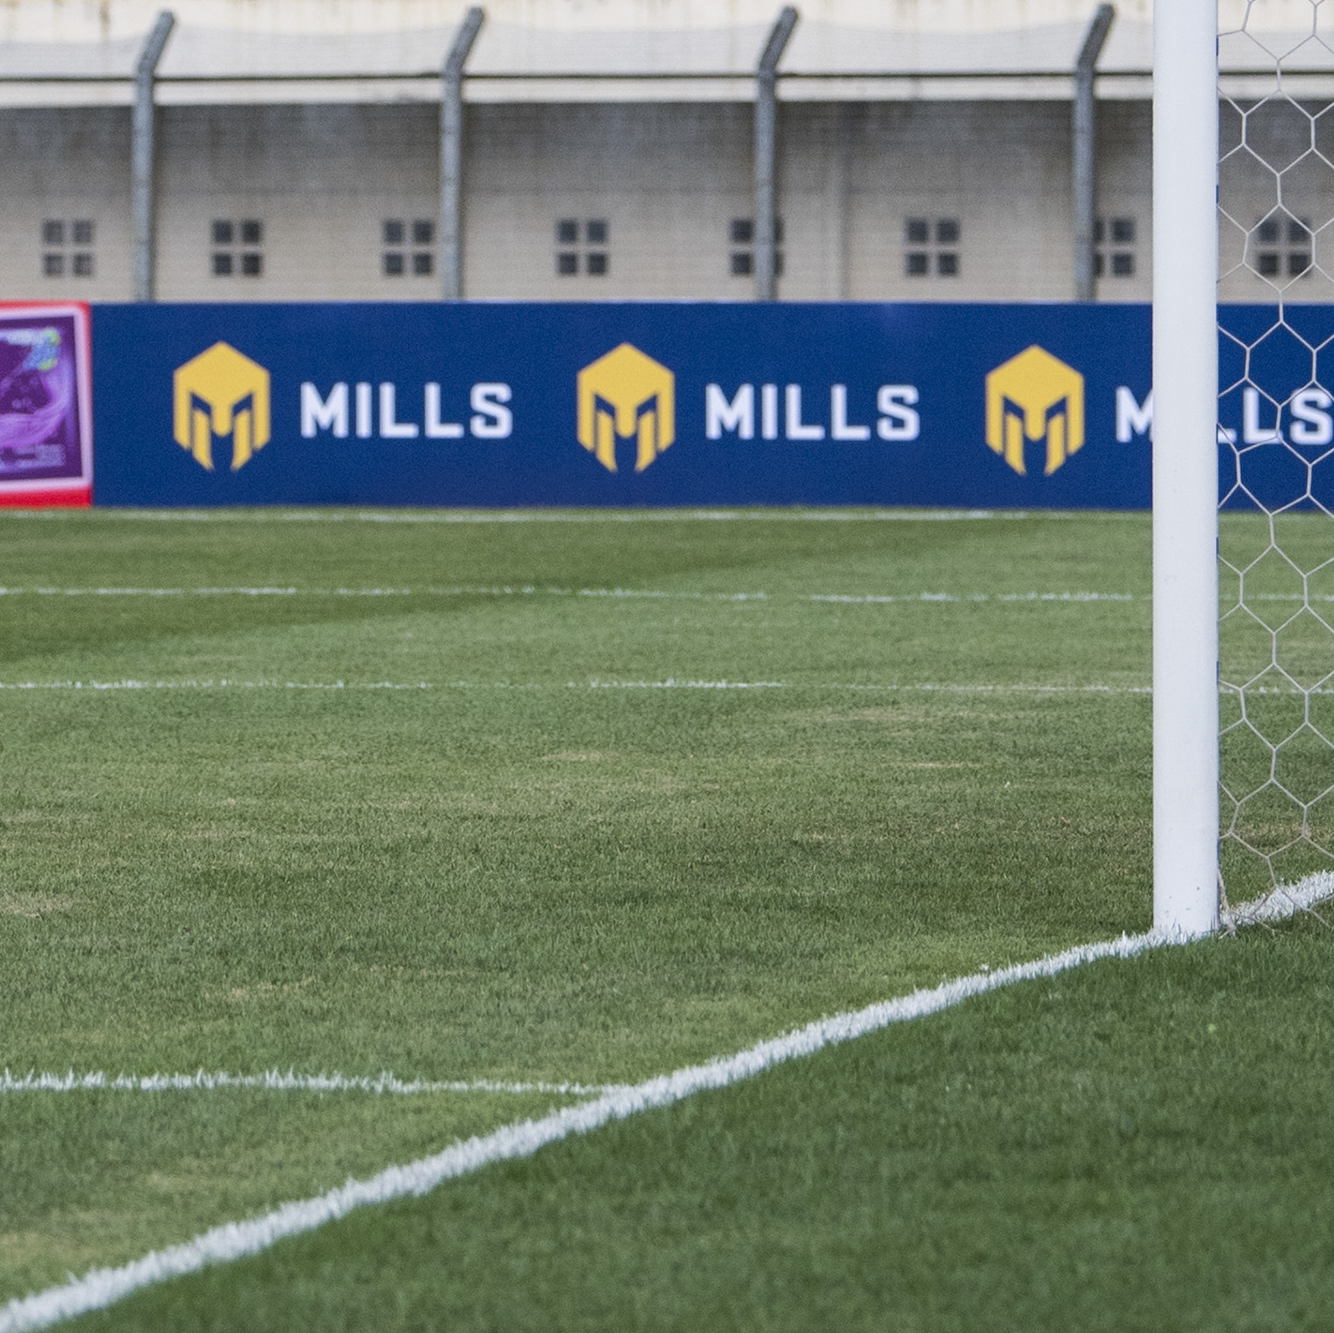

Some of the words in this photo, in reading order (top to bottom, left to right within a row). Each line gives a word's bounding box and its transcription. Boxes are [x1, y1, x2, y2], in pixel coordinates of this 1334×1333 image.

[300, 381, 514, 439] MILLS
[705, 382, 920, 441] MILLS
[1115, 384, 1334, 445] MLS
